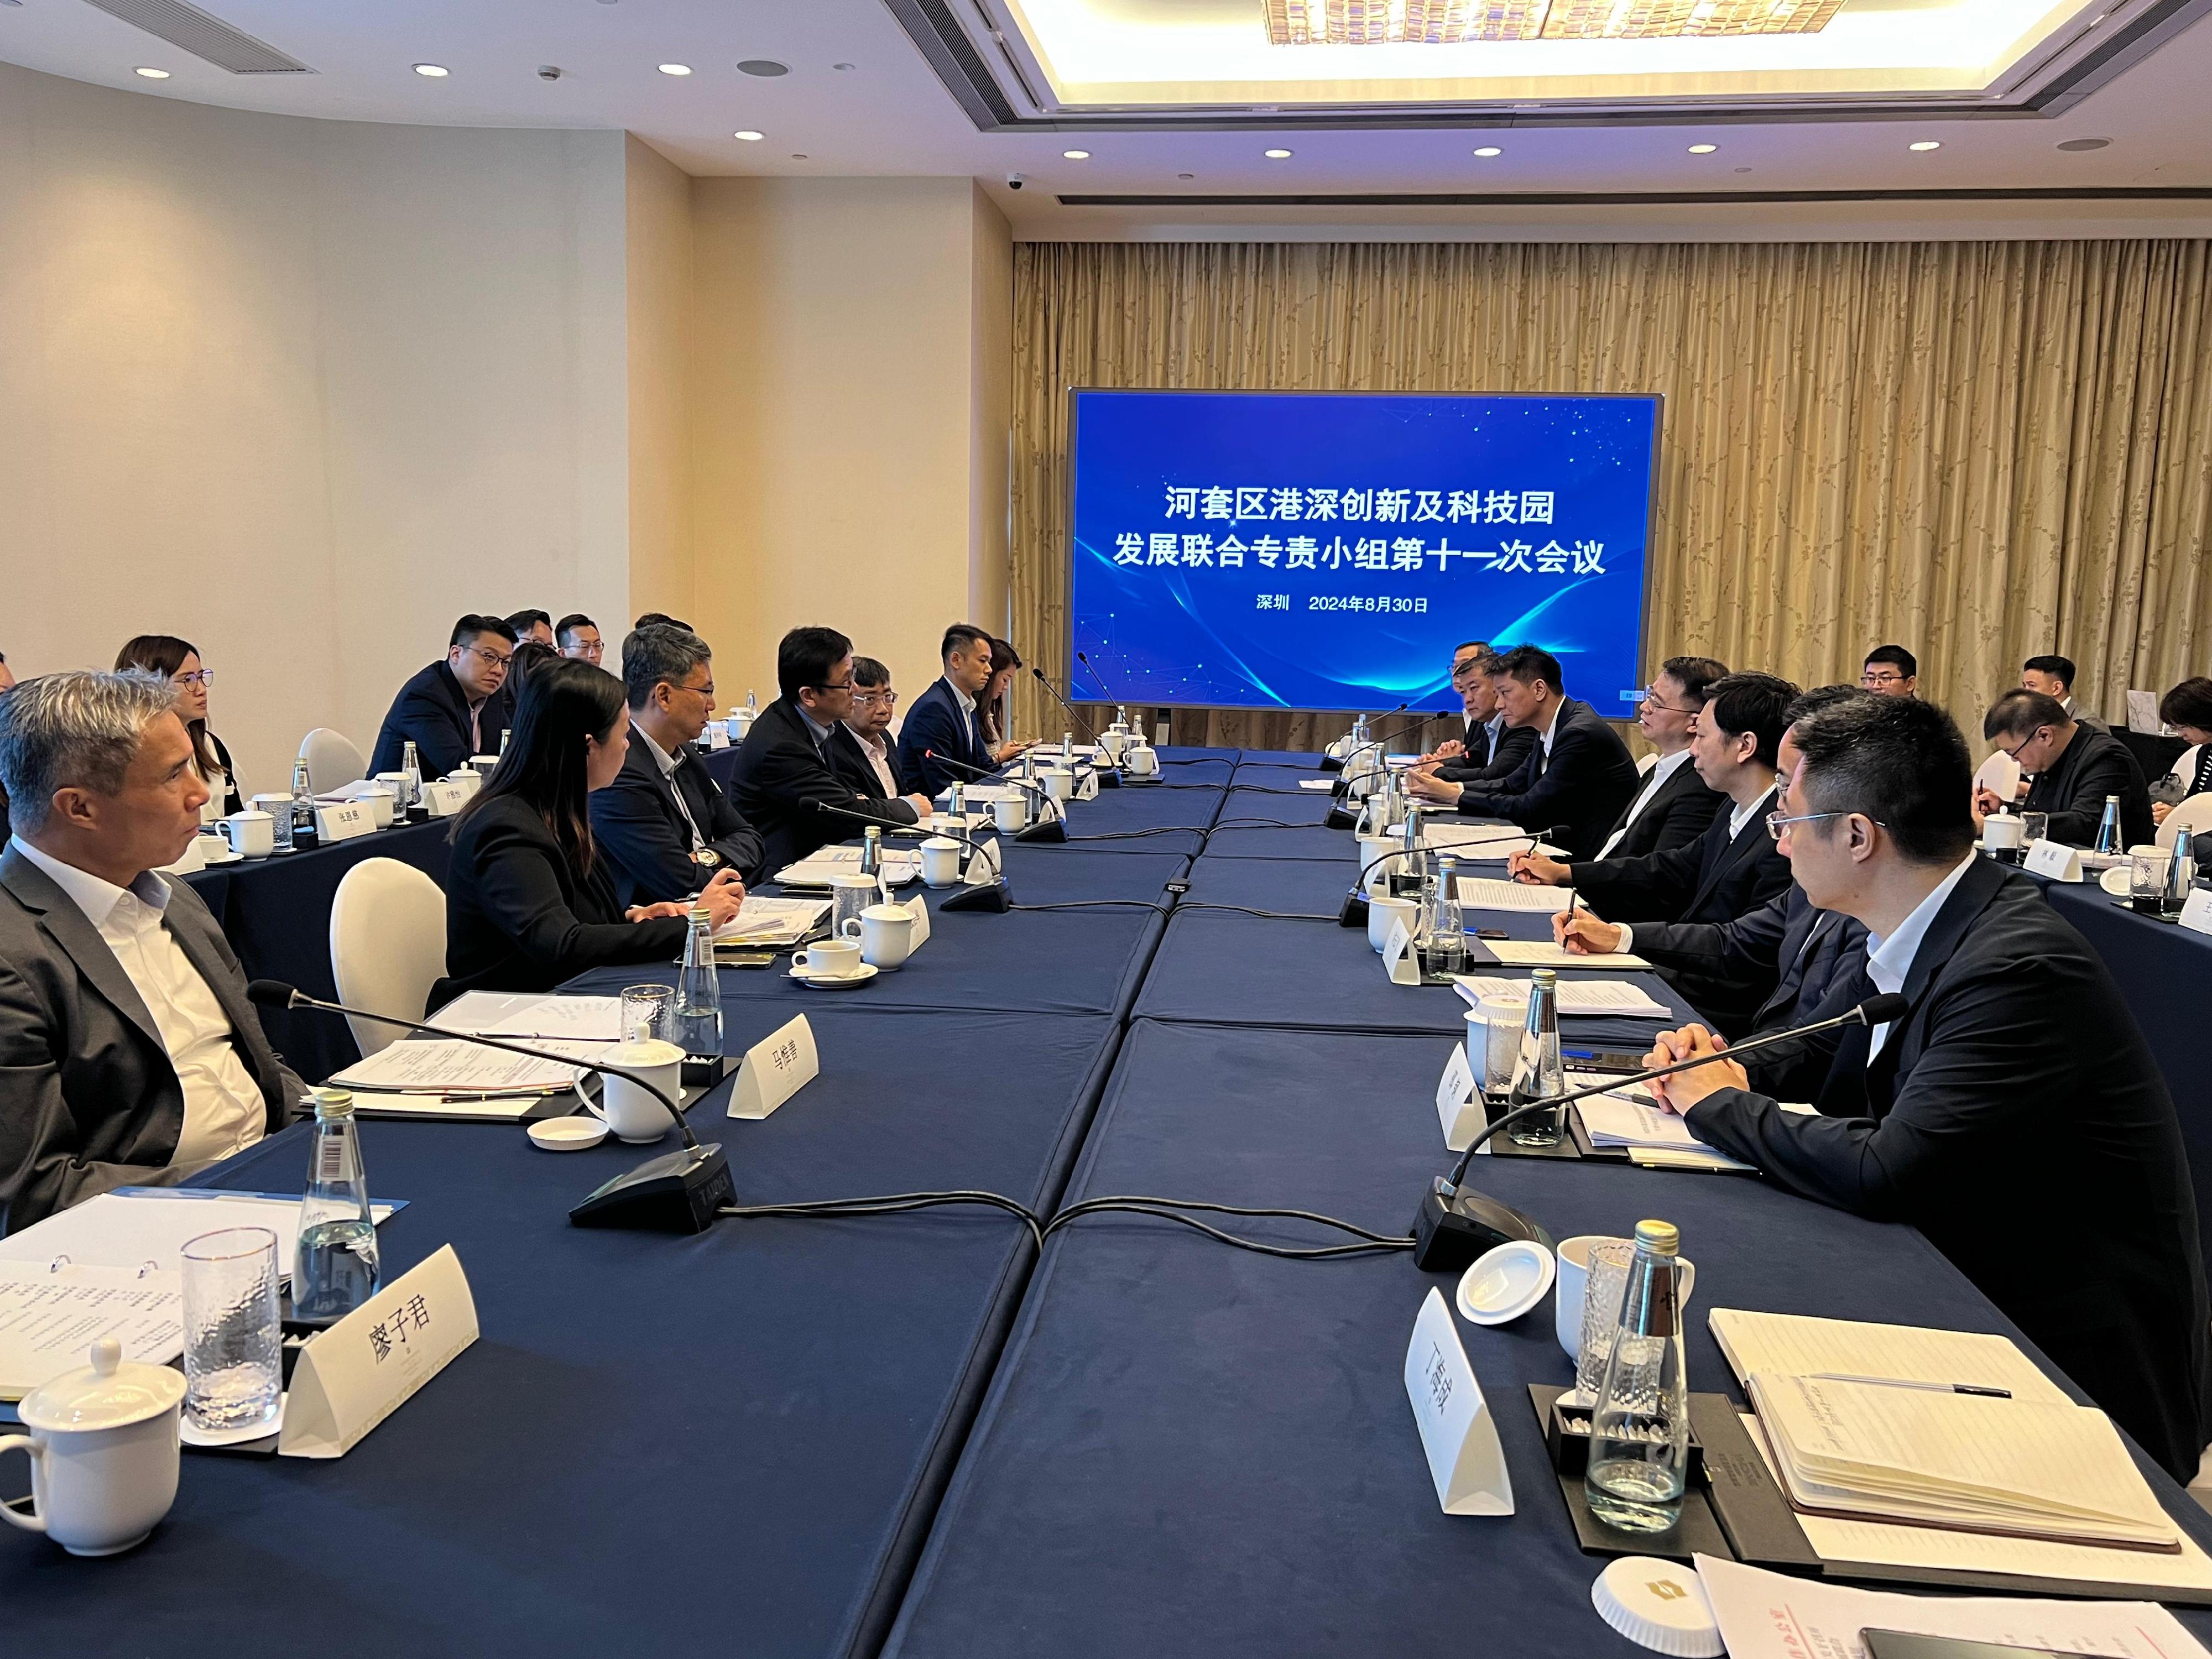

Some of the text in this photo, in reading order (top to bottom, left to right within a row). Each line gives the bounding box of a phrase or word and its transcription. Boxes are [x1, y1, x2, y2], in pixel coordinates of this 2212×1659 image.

[1164, 485, 1555, 525] 河套区港深创新及科技园
[1113, 533, 1606, 575] 发展联合专责小组第十一次会议
[1256, 593, 1428, 614] 深圳 2024年8月30日
[368, 1293, 430, 1365] 廖子君
